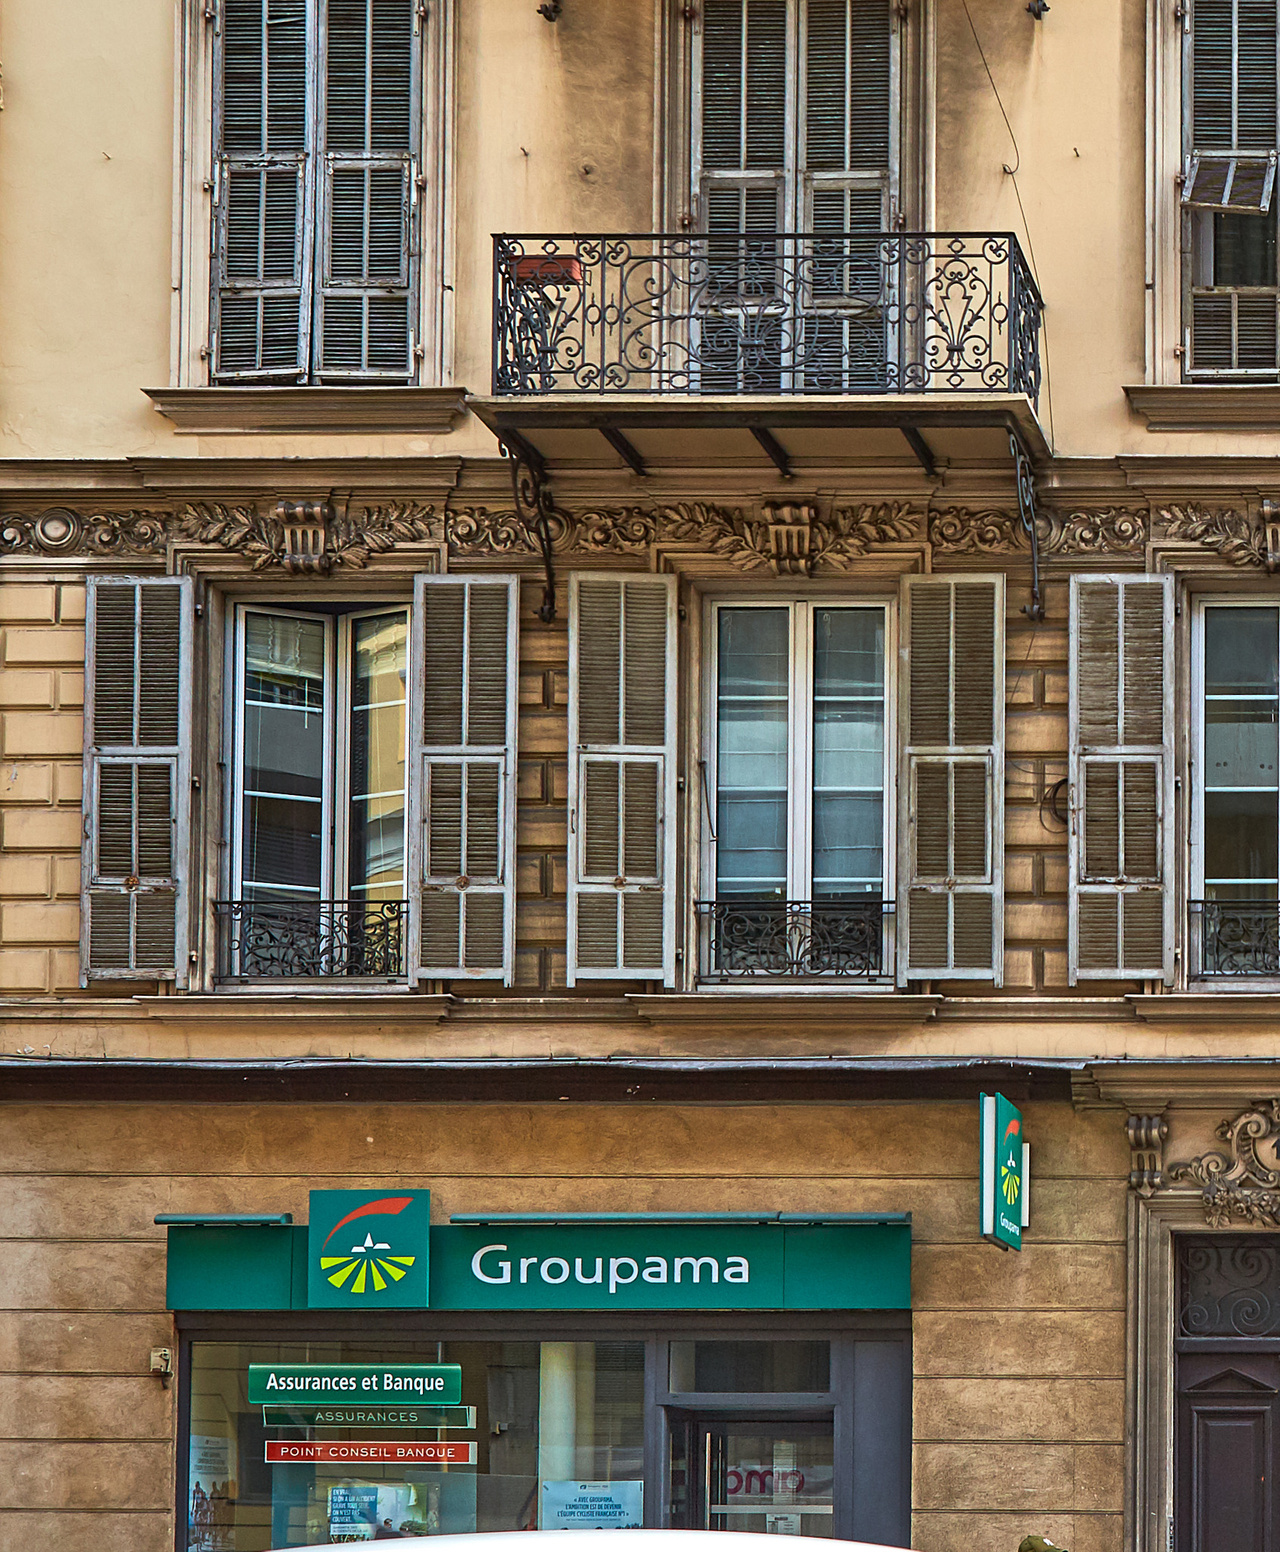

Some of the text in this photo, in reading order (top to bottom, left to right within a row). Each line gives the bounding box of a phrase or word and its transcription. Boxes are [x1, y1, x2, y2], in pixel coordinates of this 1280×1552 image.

[471, 1244, 750, 1294] Groupama
[266, 1373, 445, 1395] Assurances et Banque
[315, 1411, 419, 1422] ASSURANCES
[280, 1447, 456, 1458] POINT CONSEIL BANQUE
